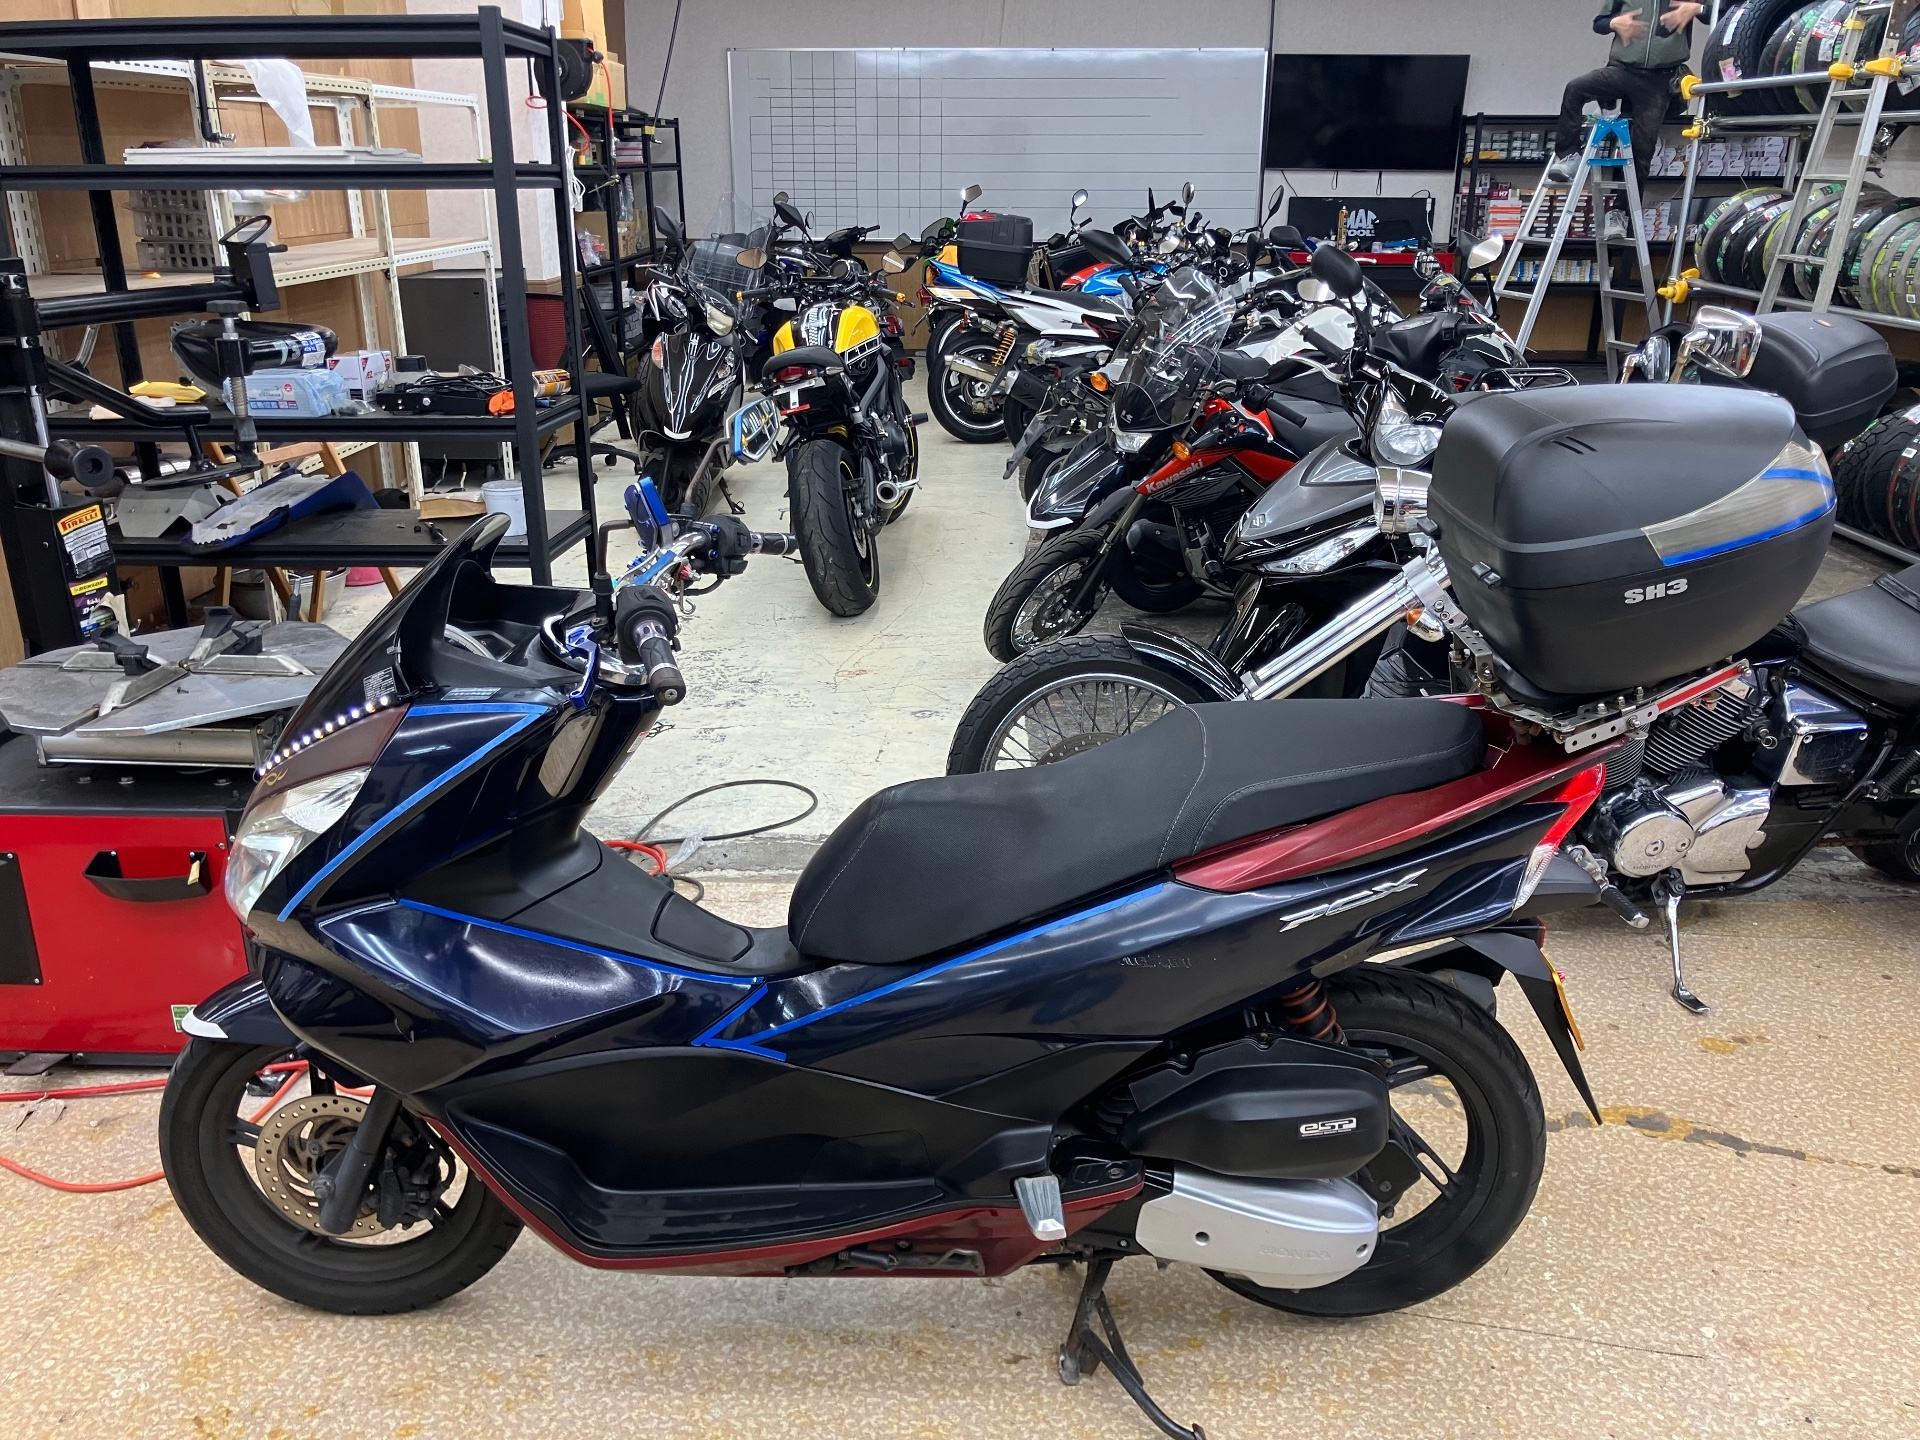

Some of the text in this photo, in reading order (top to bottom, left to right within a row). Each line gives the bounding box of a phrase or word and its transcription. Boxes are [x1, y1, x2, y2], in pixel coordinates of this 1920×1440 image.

[1145, 458, 1204, 494] Kawasaki
[60, 508, 99, 531] PIRELLI
[78, 580, 105, 592] DUNLOP
[1624, 578, 1689, 605] SH3
[1257, 1245, 1331, 1260] HONDA
